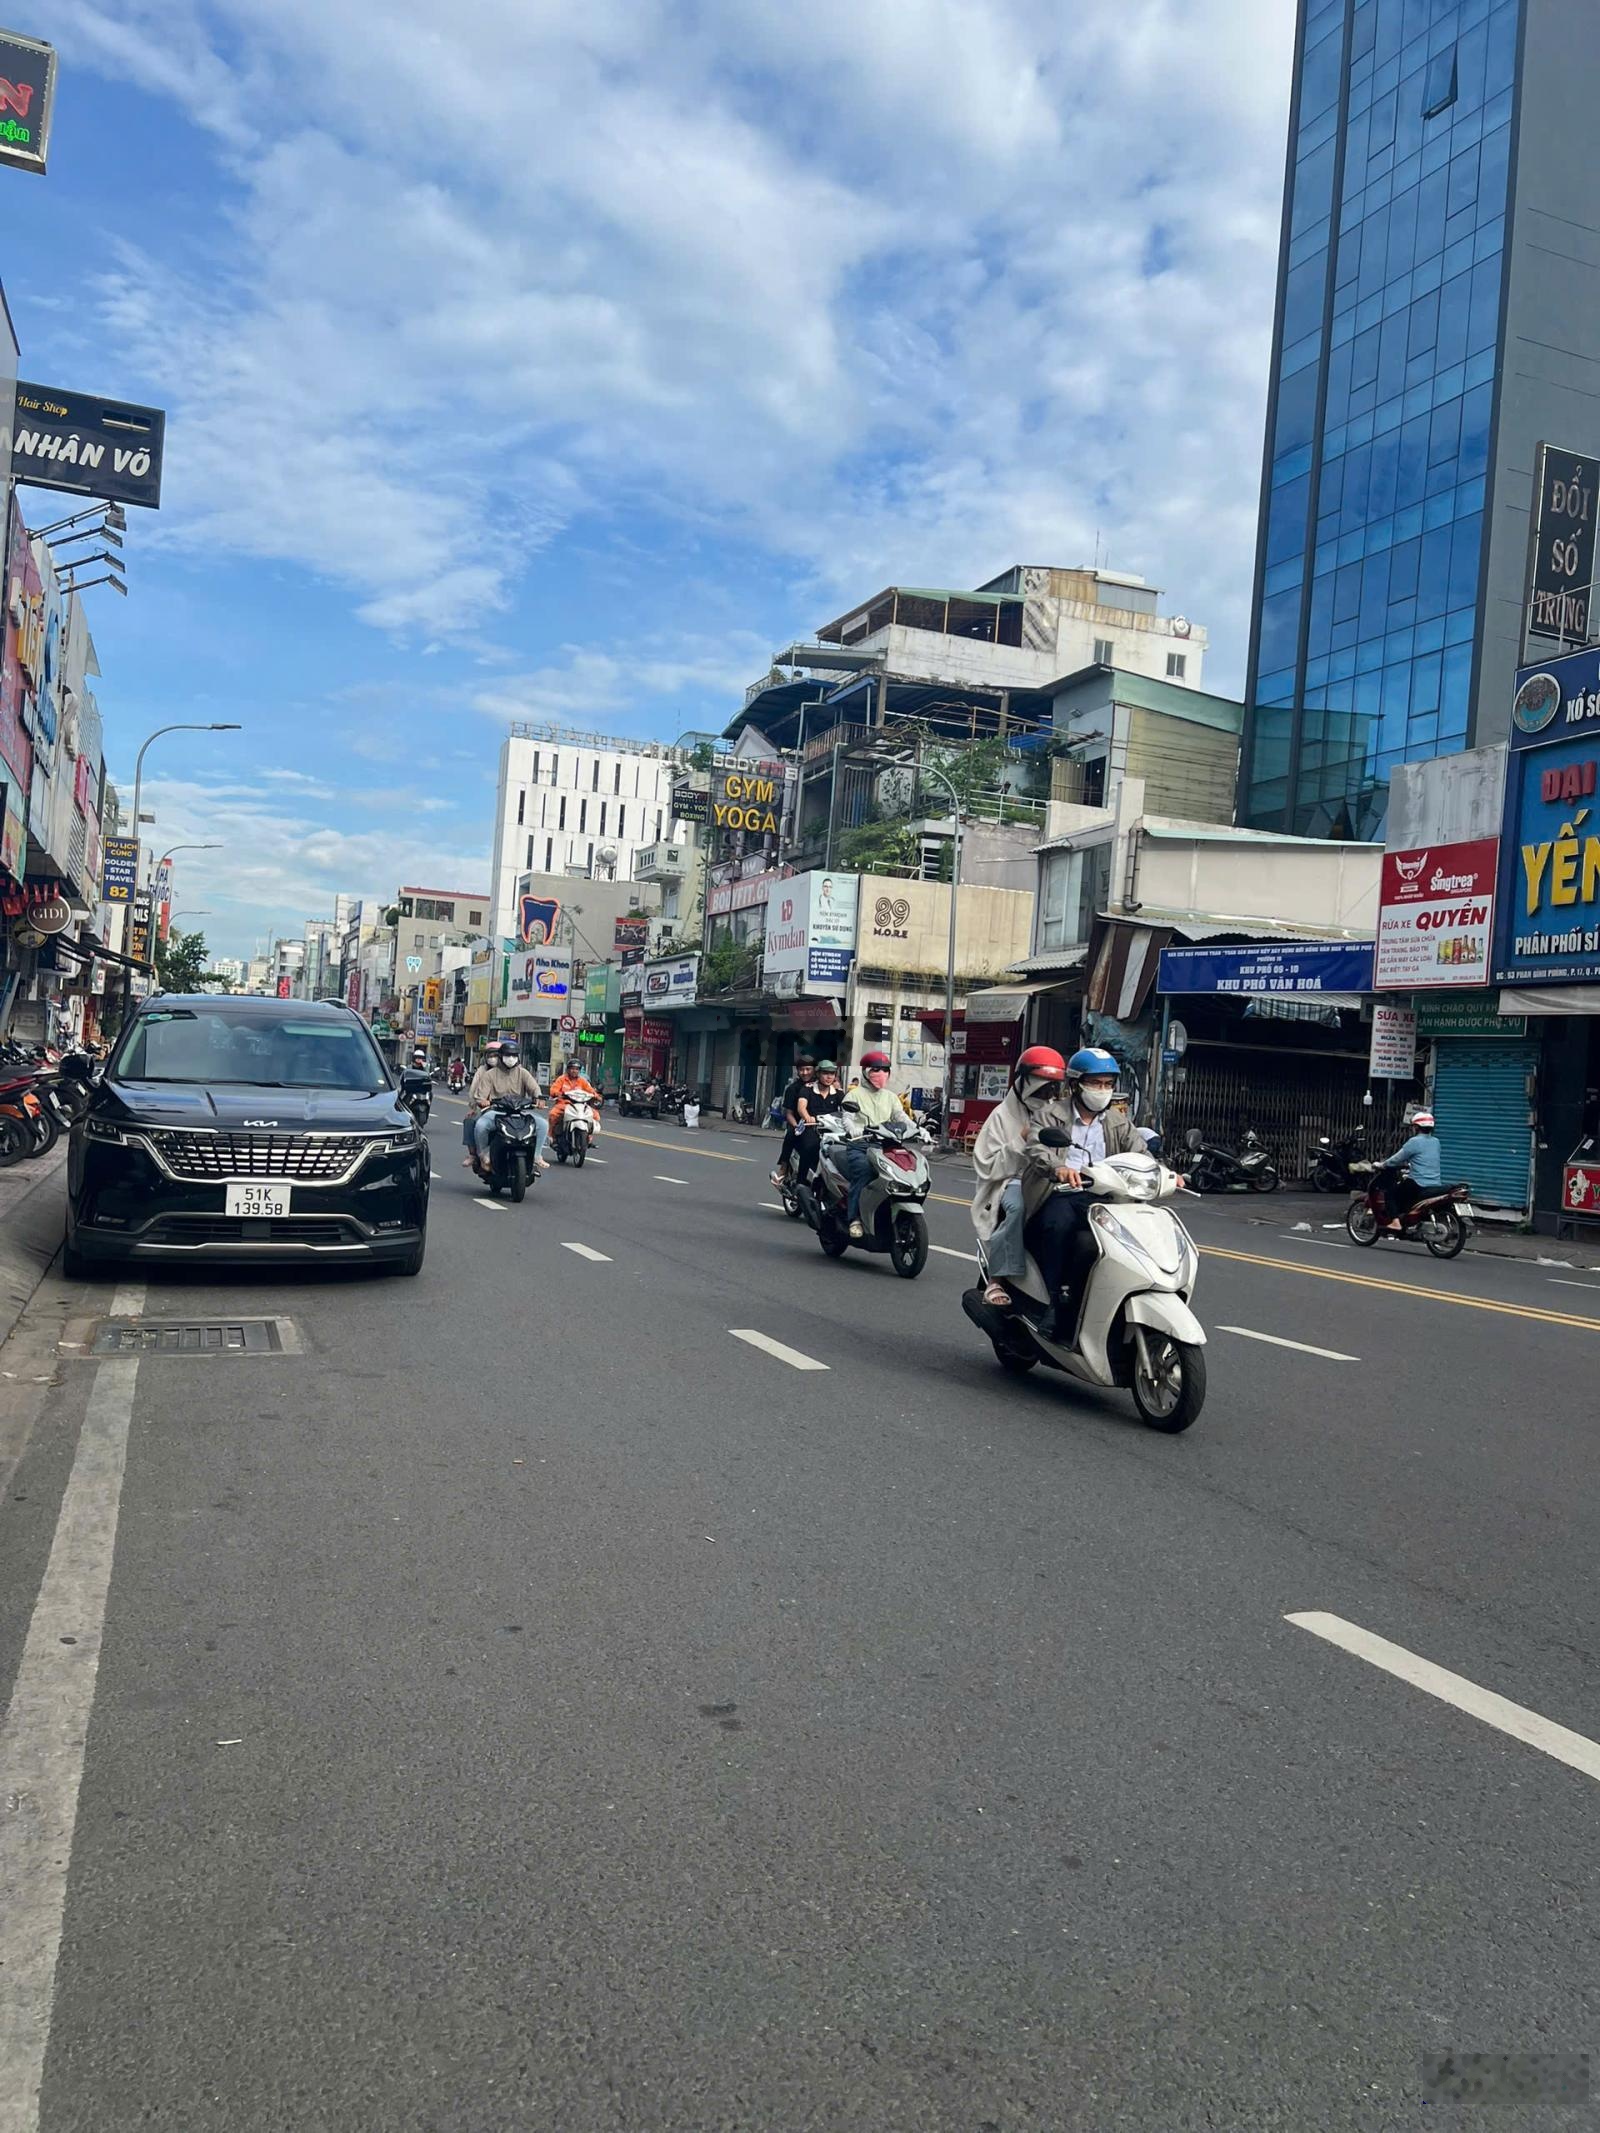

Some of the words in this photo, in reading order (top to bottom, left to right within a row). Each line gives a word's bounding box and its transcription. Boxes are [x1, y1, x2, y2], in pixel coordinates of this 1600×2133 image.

[17, 396, 41, 410] Hair
[43, 401, 68, 417] Shop
[14, 430, 105, 468] NHÂN
[113, 447, 151, 477] VÕ
[1551, 465, 1591, 521] ĐỔI
[1551, 528, 1582, 577] SỐ
[1566, 687, 1586, 723] XỔ
[725, 775, 774, 803] GYM
[673, 802, 688, 810] GYM
[680, 811, 705, 820] BOXING
[714, 804, 776, 834] YOGA
[105, 858, 137, 868] GOLDEN
[110, 867, 131, 875] STAR
[105, 874, 134, 884] TRAVEL
[1431, 869, 1473, 891] Singtrea
[109, 886, 128, 898] 82
[33, 909, 64, 920] GIDI
[875, 897, 910, 927] 89
[1381, 918, 1400, 930] RỬA
[1401, 919, 1411, 929] XE
[768, 928, 805, 956] Kymdan
[1515, 930, 1549, 955] PHÂN
[1550, 926, 1582, 953] PHỐI
[1240, 966, 1255, 974] KHU
[1217, 980, 1240, 990] KHU
[1243, 975, 1267, 990] PHỐ
[1269, 977, 1294, 990] VĂN
[1297, 976, 1322, 990] HOÁ
[1403, 1012, 1415, 1023] XE
[244, 1188, 272, 1201] 51K
[234, 1203, 283, 1216] 139.58
